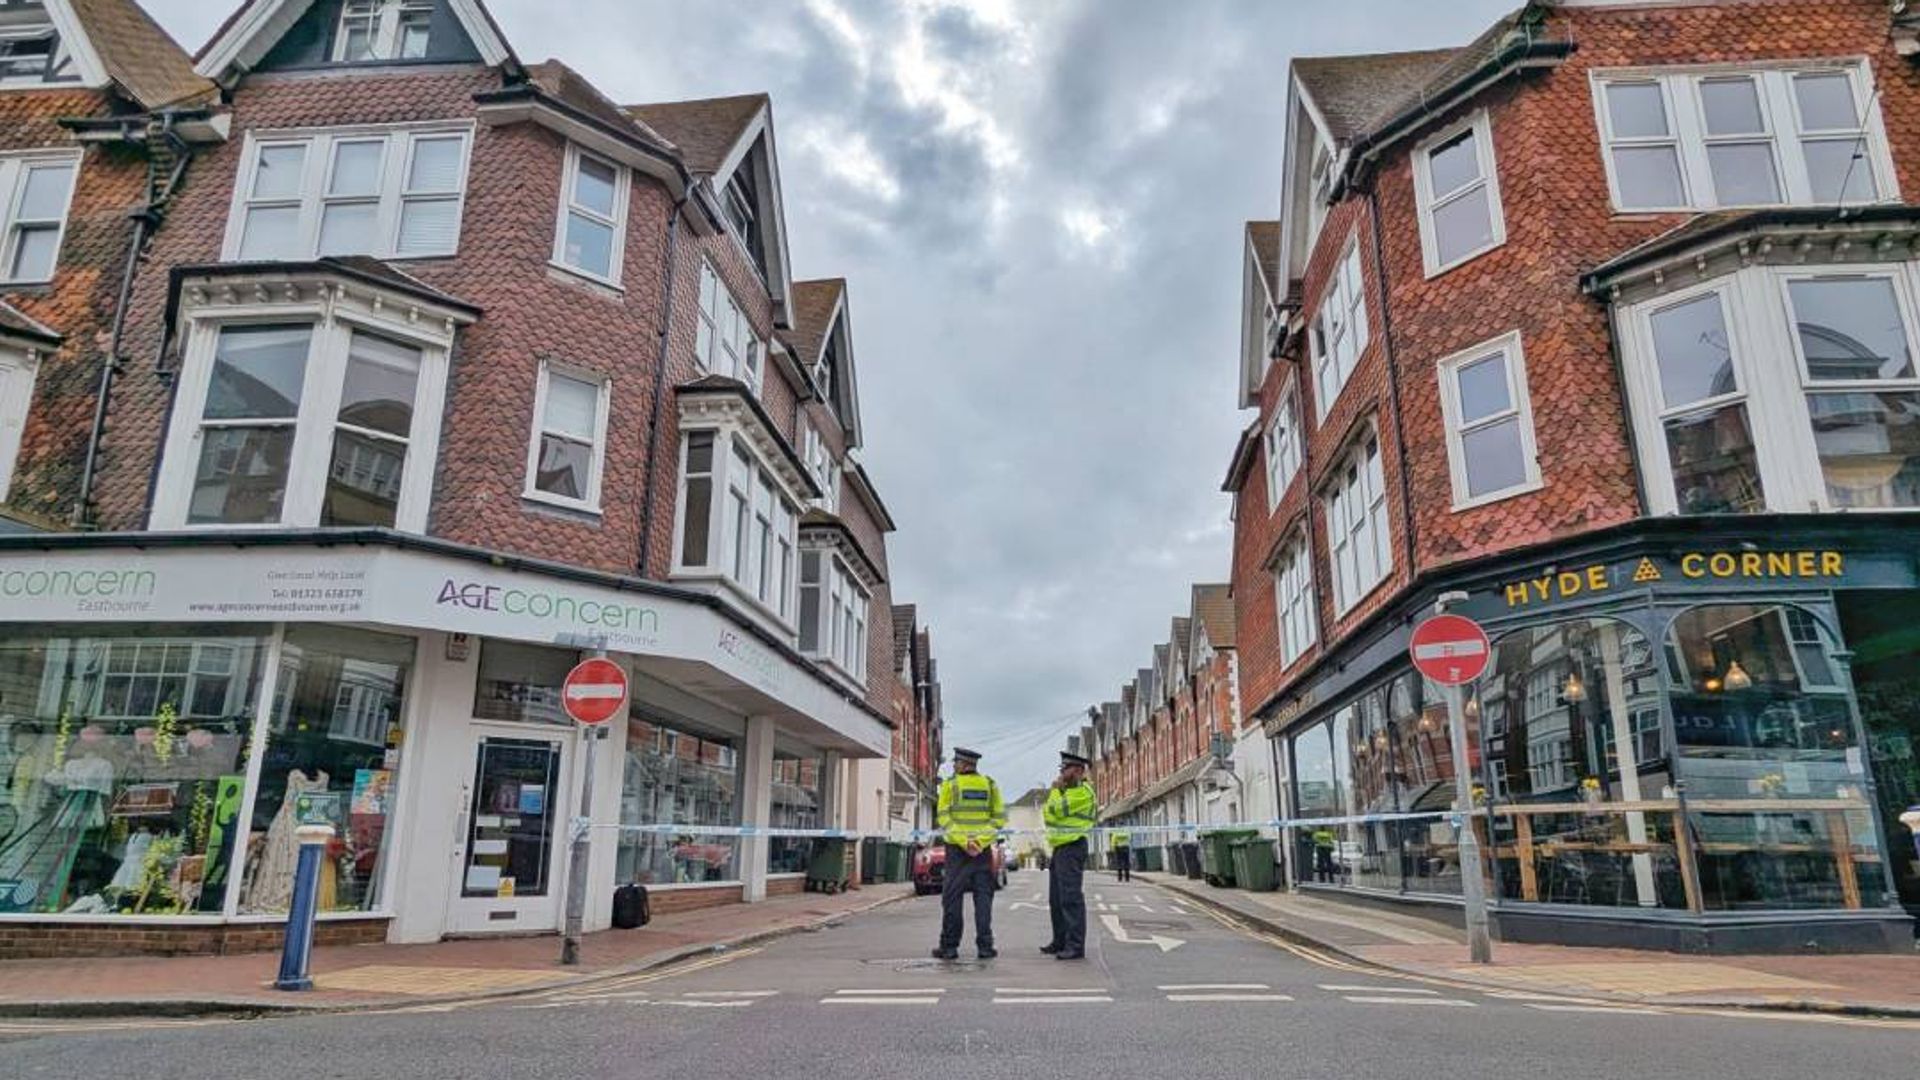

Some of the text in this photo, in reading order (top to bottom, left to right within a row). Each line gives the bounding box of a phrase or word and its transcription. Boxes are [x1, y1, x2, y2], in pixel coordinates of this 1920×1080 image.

[0, 570, 156, 597] concern
[1506, 552, 1843, 606] HYDE CORNER
